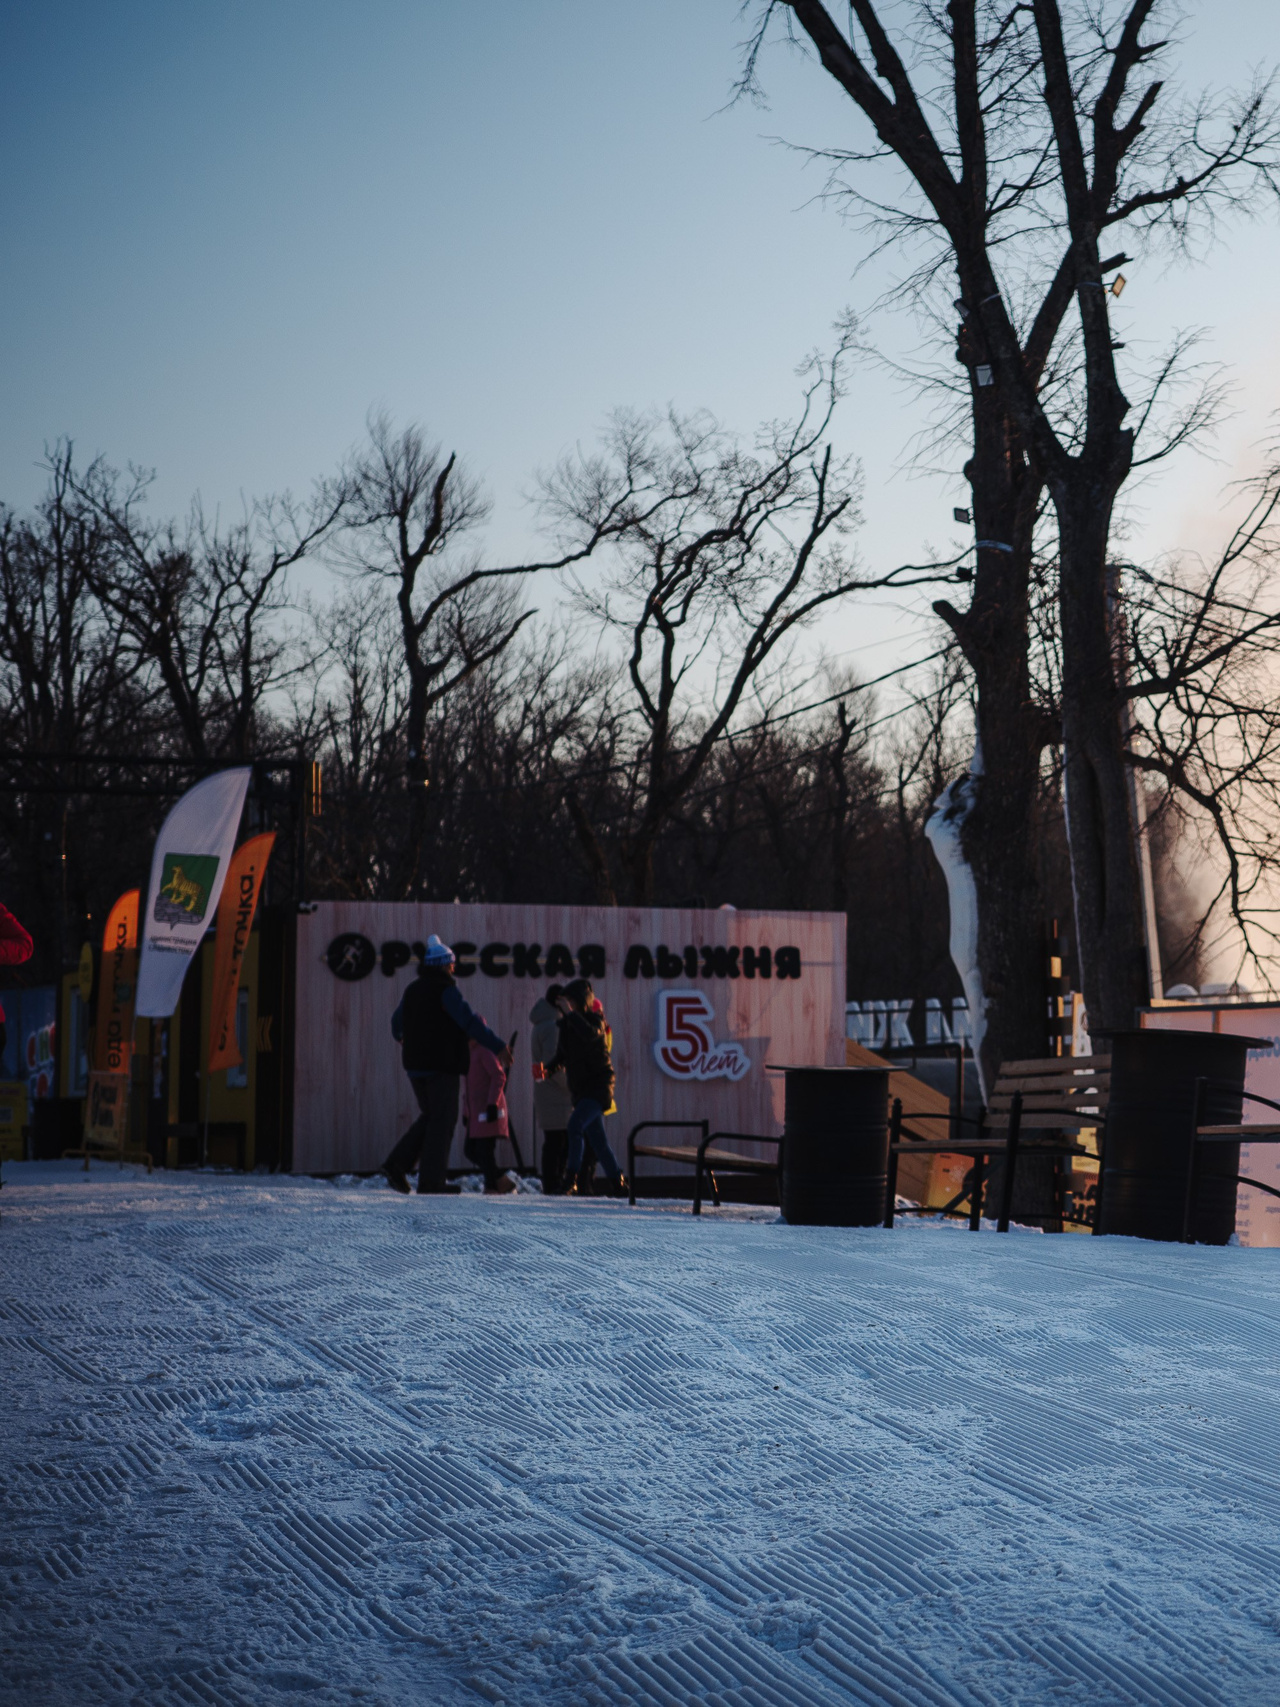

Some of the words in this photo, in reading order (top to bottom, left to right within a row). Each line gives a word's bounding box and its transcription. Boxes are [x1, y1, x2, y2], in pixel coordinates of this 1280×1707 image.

[623, 944, 801, 979] ЛЫЖНЯ
[661, 997, 708, 1073] 5
[691, 1049, 744, 1074] лет
